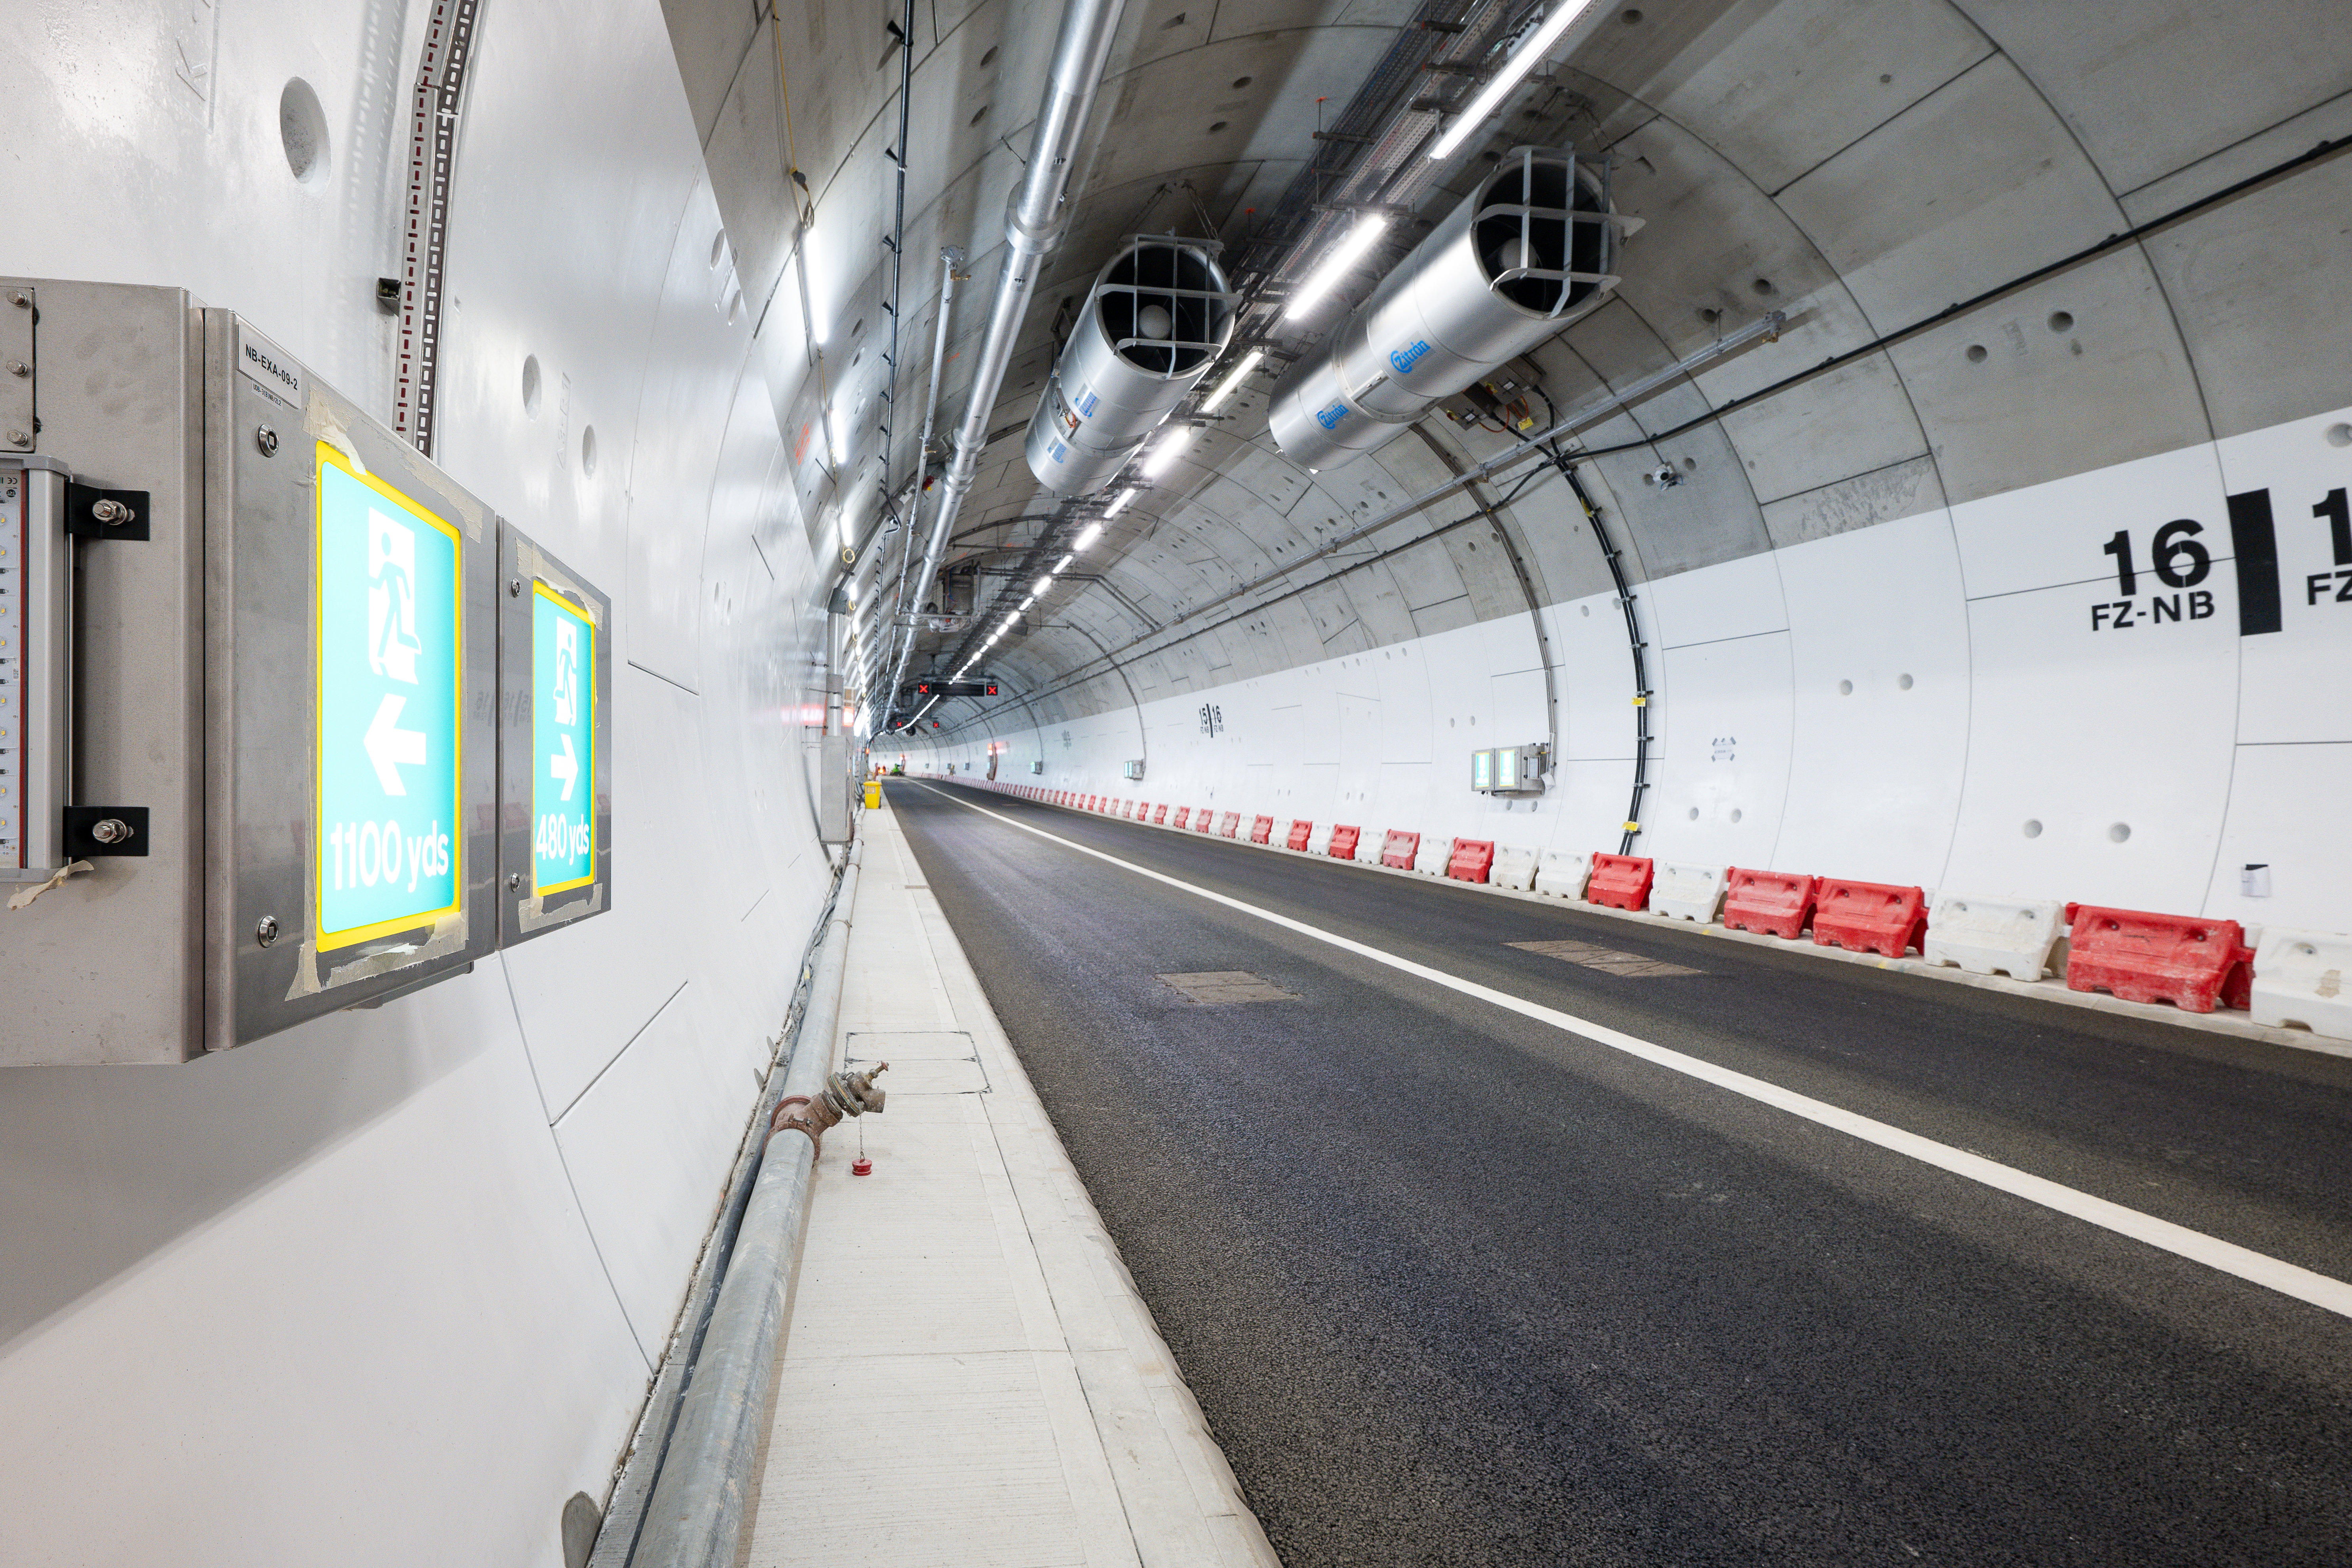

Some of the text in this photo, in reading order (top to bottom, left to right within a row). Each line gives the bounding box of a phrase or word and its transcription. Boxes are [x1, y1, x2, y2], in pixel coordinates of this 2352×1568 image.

[245, 343, 298, 390] NB-EXA-09-2
[2103, 519, 2210, 596] 16
[2091, 590, 2215, 631] FZ-NB
[1199, 707, 1208, 725] 15
[1212, 705, 1222, 724] 16
[330, 819, 449, 893] 1100 yds
[536, 813, 589, 866] 480 yds
